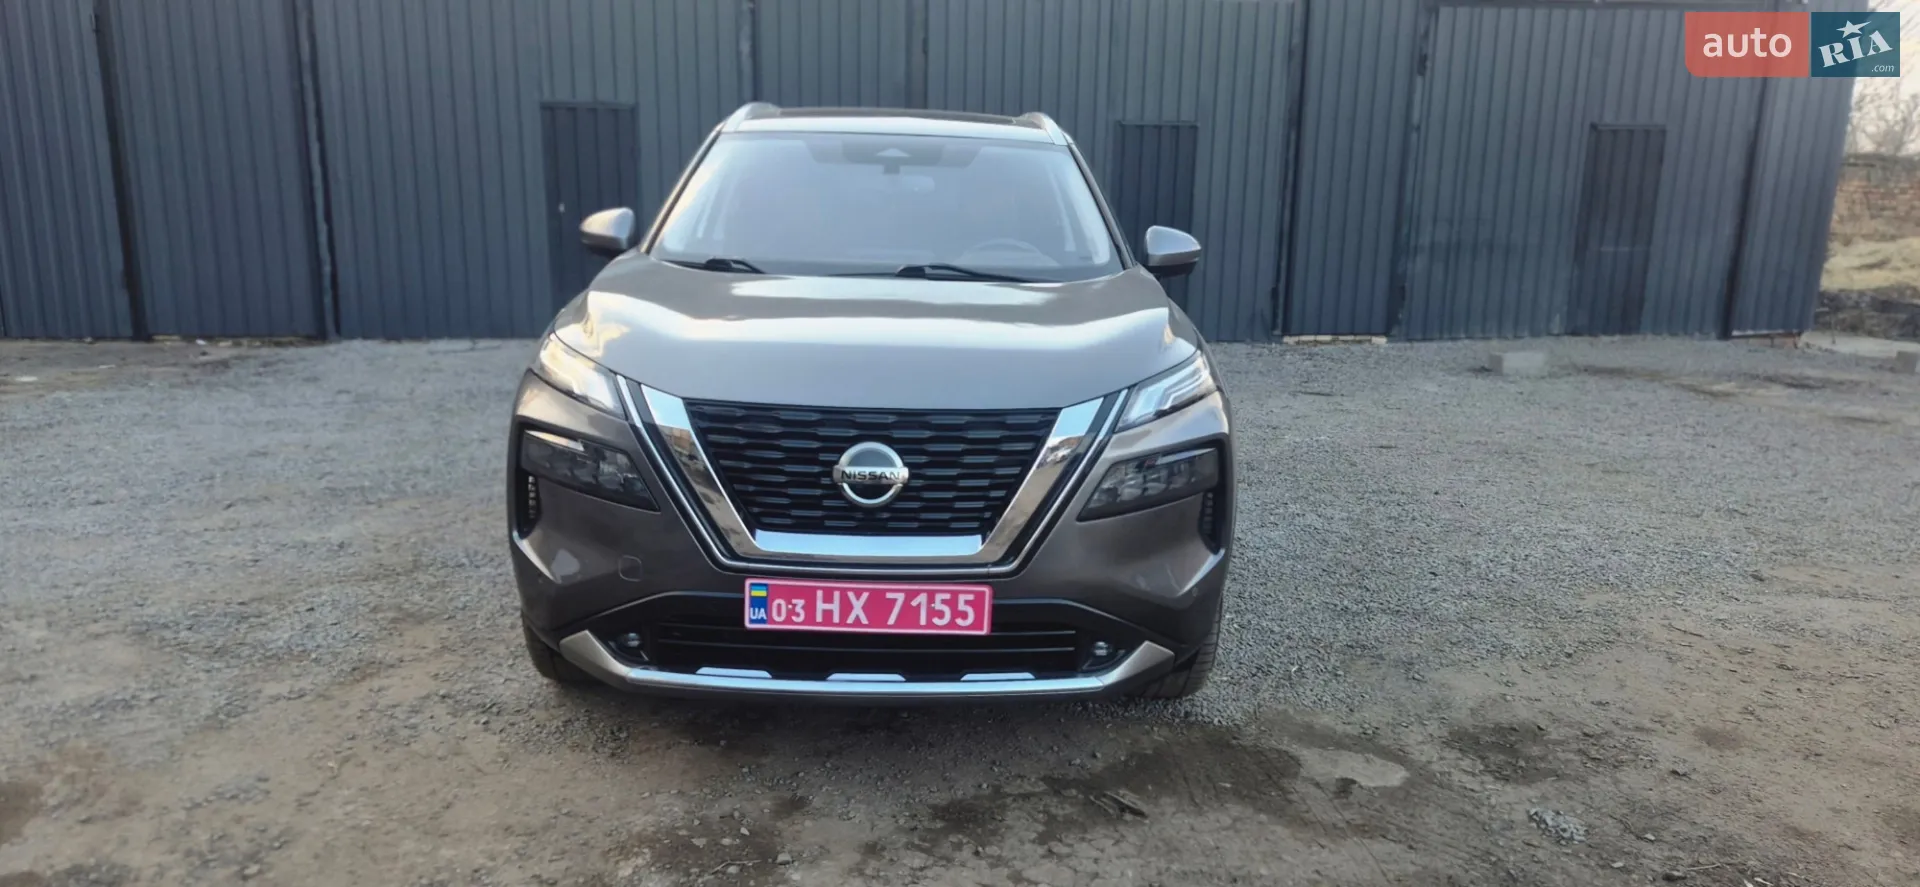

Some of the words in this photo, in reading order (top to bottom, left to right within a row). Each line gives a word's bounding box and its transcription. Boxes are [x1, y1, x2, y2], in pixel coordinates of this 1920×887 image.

[841, 470, 901, 481] NISSAN
[750, 607, 767, 620] UA
[771, 598, 805, 623] 03
[815, 589, 870, 625] HX
[885, 592, 975, 627] 7155
